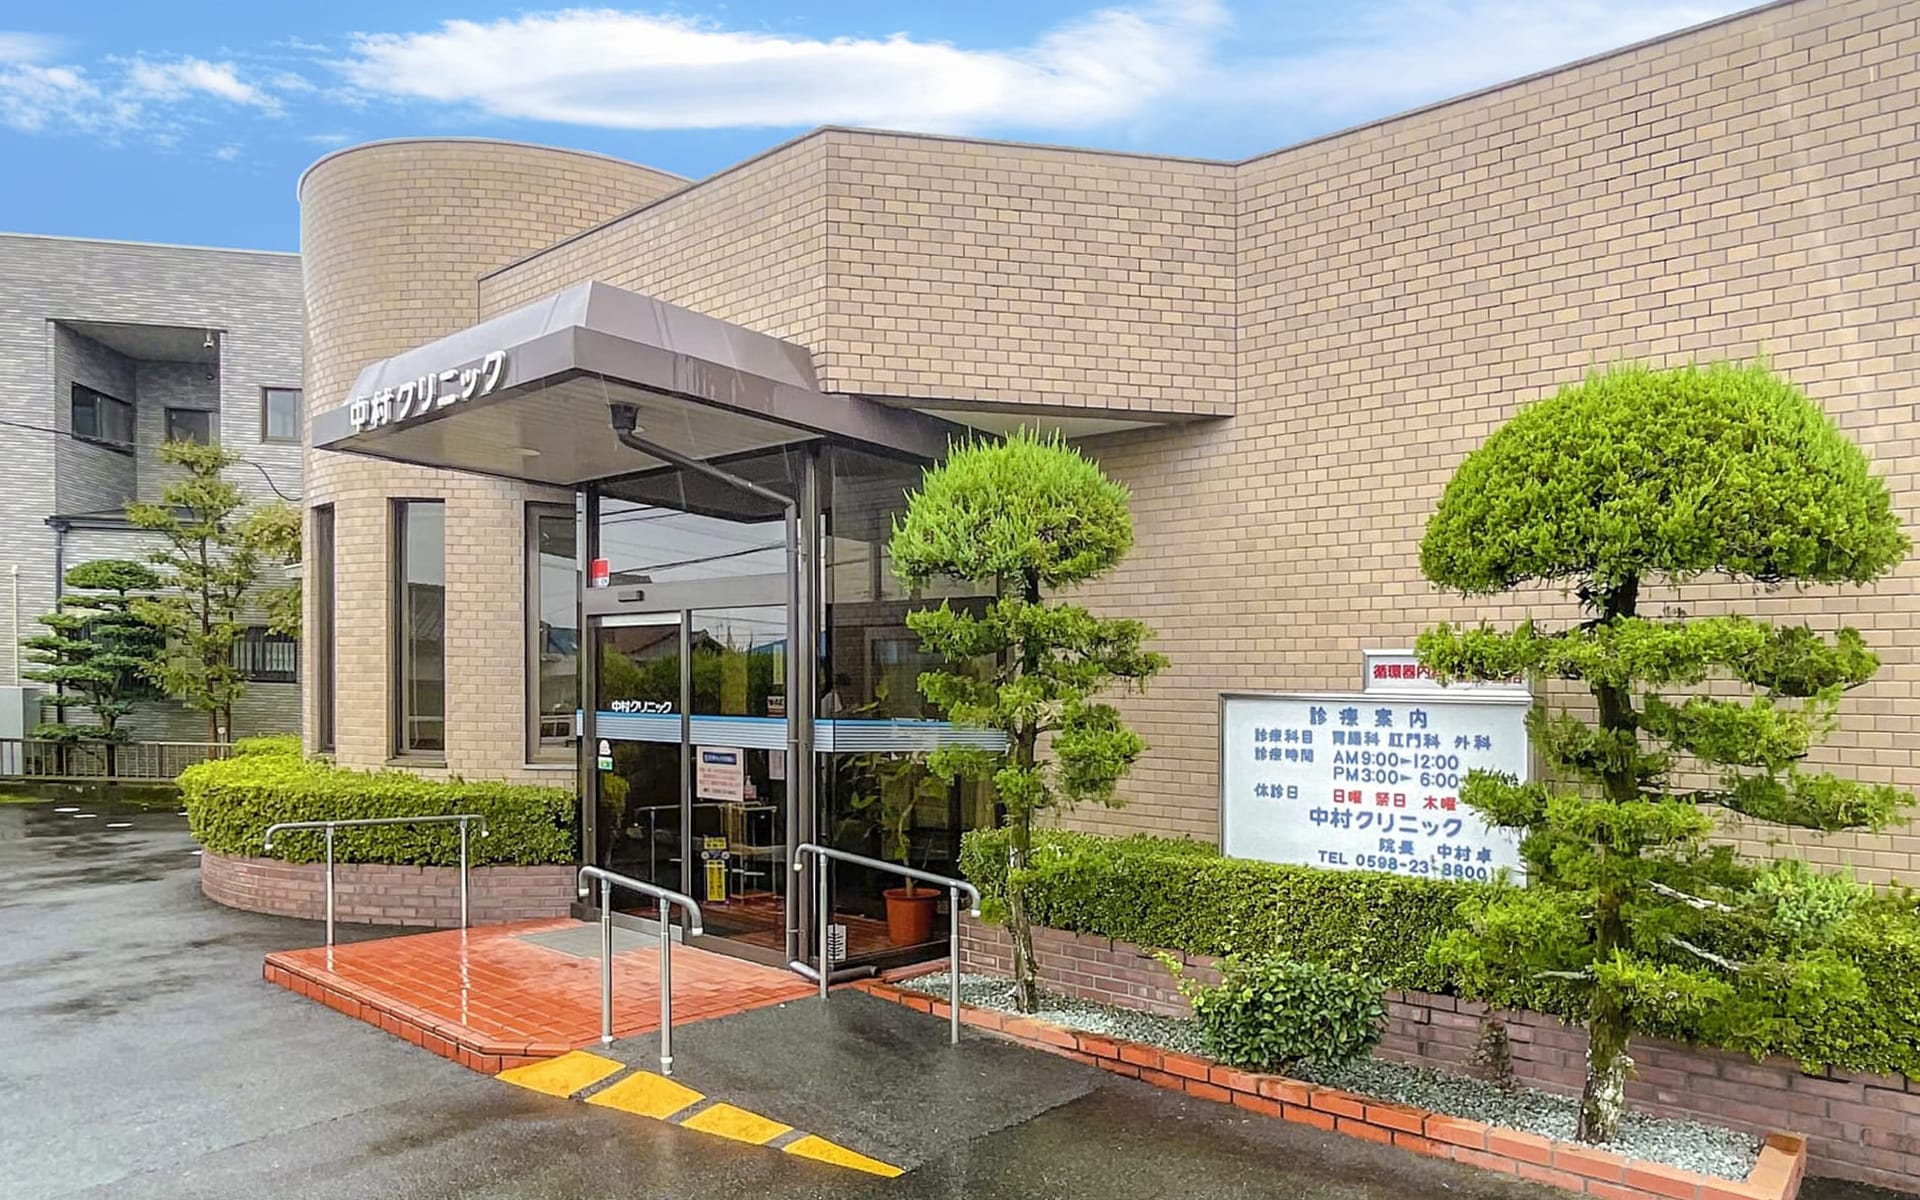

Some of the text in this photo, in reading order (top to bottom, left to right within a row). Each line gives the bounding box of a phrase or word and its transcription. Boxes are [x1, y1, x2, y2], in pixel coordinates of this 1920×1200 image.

[350, 350, 507, 433] 中村クリニック
[611, 700, 673, 714] 中村クリニック
[1309, 706, 1428, 729] 診療案内
[1254, 728, 1492, 750] 診療科目 胃腸科 肛門科 外科
[1254, 746, 1314, 763] 診療時間
[1254, 783, 1457, 811] 休診日 日曜 祭日 木曜
[1309, 806, 1463, 838] 中村クリニック
[1379, 837, 1415, 856] 院長
[1318, 850, 1348, 866] TEL
